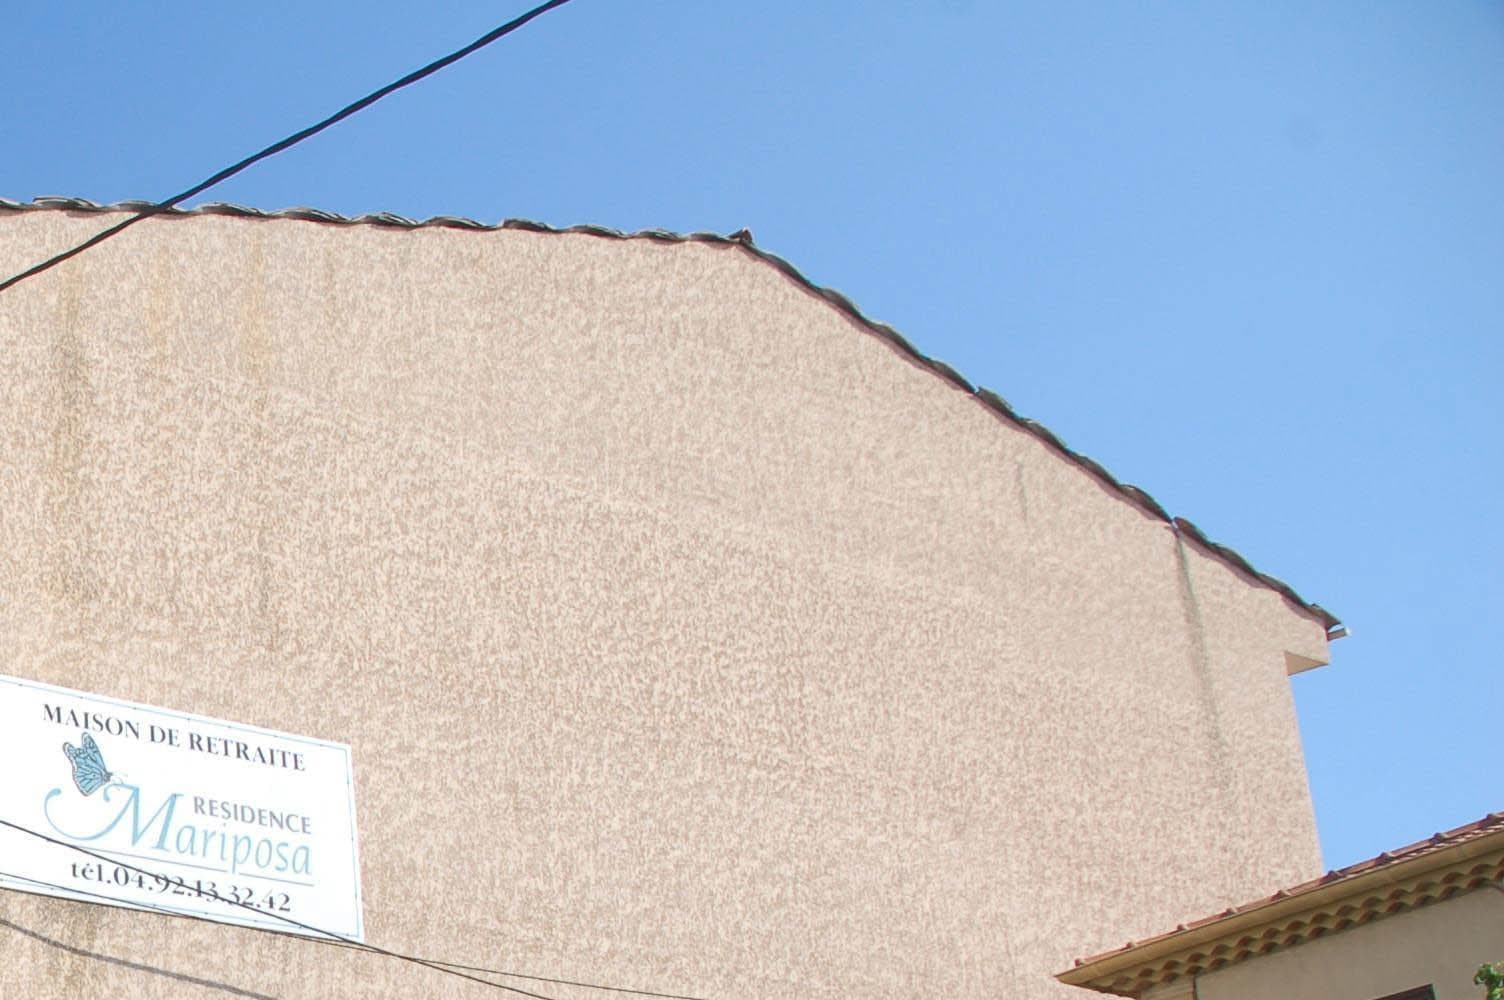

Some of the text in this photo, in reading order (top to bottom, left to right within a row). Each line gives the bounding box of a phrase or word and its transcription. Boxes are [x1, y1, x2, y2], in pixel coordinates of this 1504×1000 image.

[43, 703, 307, 772] MAISON DE RETRAITE
[44, 783, 314, 876] Mariposa
[193, 796, 312, 835] RESIDENCE
